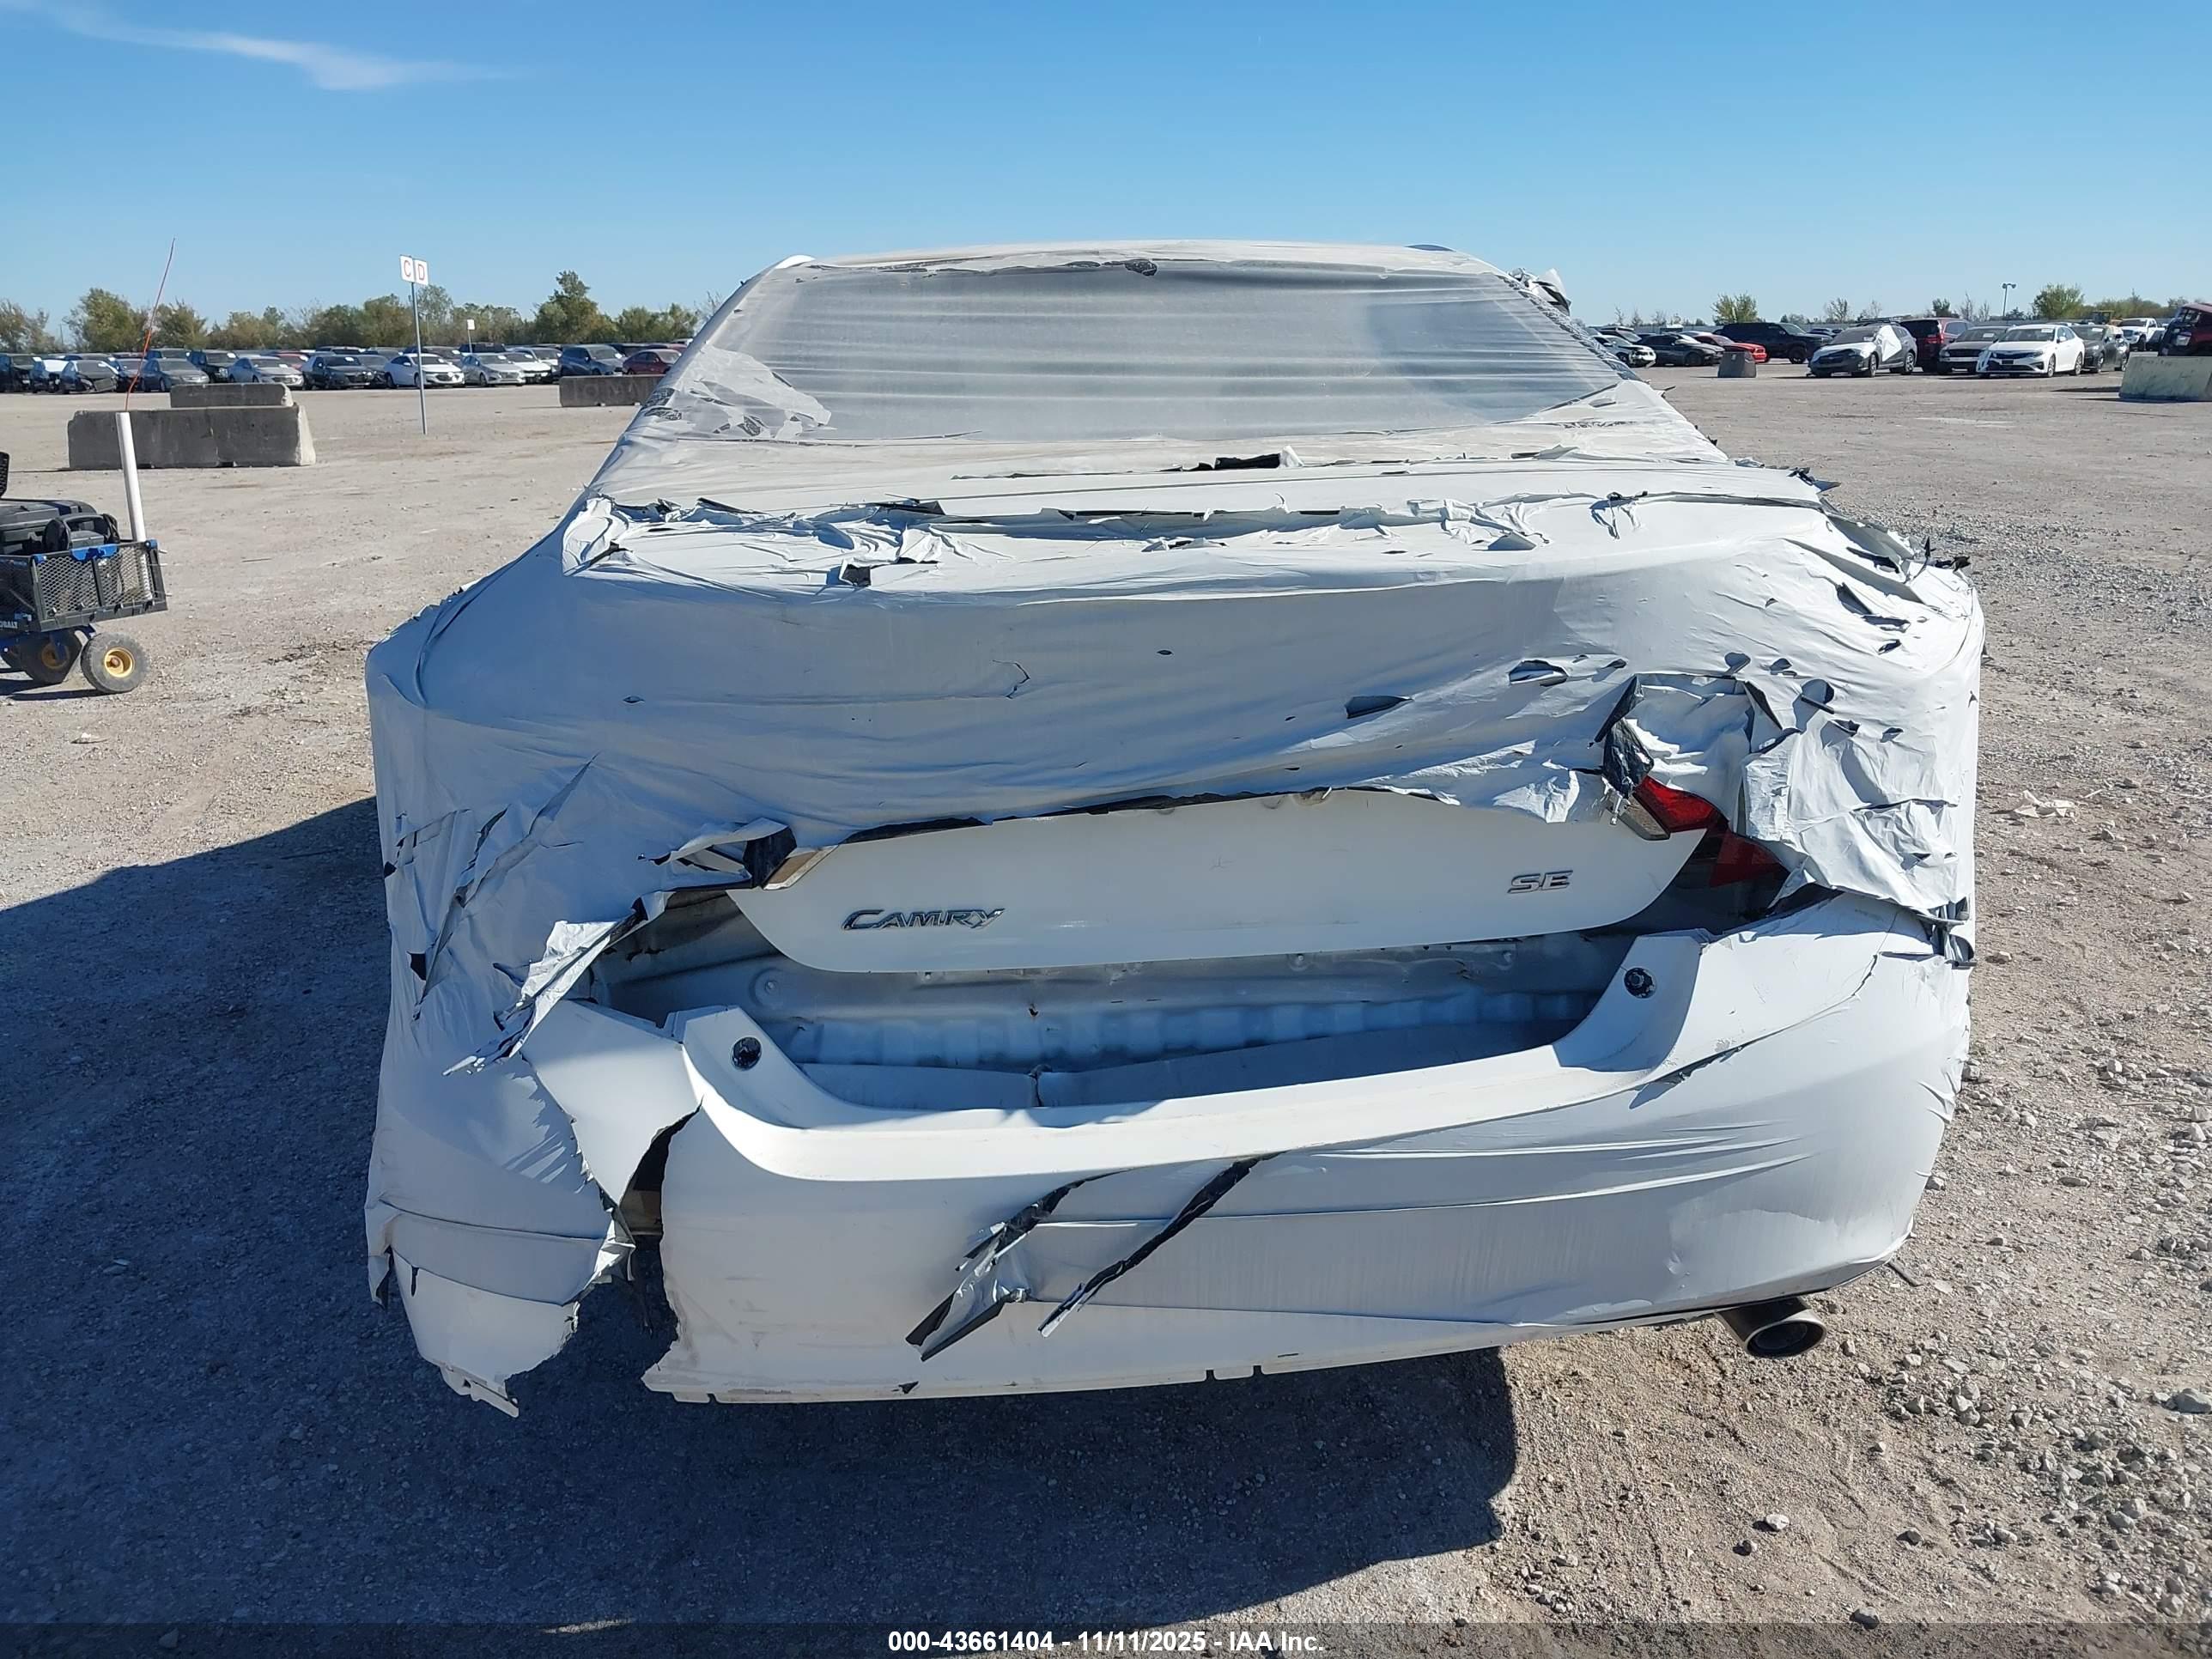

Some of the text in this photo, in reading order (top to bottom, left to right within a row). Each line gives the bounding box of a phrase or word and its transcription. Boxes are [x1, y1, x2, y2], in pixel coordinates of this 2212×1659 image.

[404, 259, 411, 277] C
[417, 263, 425, 281] D
[1506, 869, 1573, 894] SE
[841, 907, 1006, 931] CAMRY
